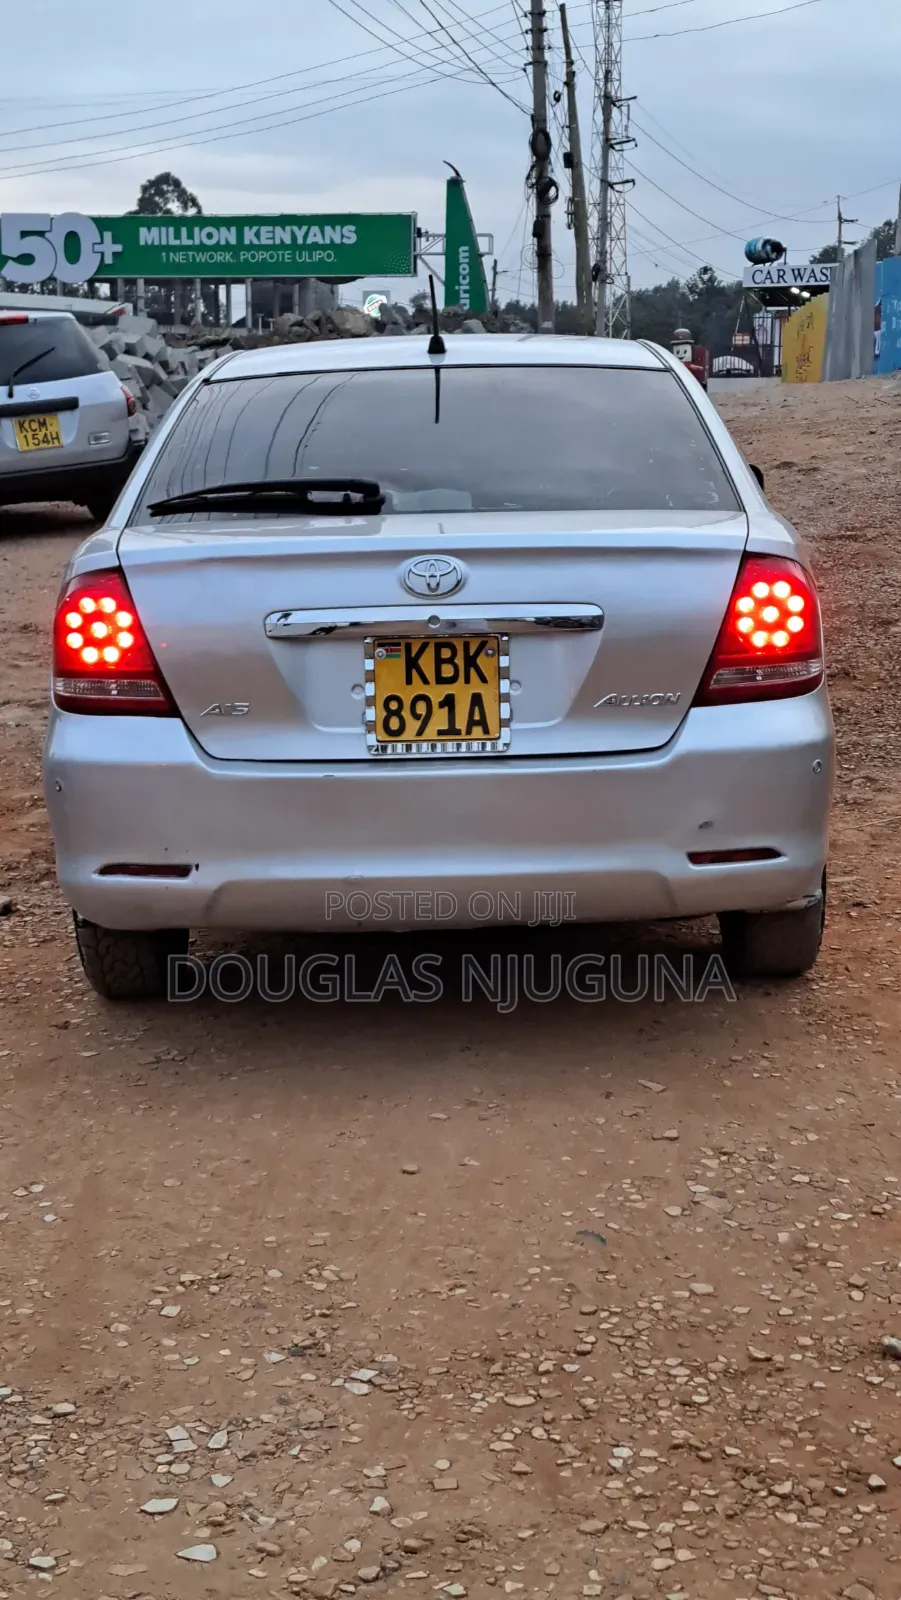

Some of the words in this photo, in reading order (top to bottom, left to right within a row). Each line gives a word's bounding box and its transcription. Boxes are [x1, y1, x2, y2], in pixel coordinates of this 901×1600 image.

[139, 226, 237, 246] MILLION
[243, 225, 357, 245] KENYANS
[0, 212, 123, 284] 50+
[161, 252, 167, 263] 1
[169, 251, 236, 263] NETWORK.
[240, 250, 292, 263] POPOTE
[296, 250, 337, 262] ULIPO.
[752, 268, 788, 285] CAR
[18, 417, 48, 433] KCM
[23, 431, 60, 447] 154H
[404, 640, 488, 686] KBK
[382, 692, 490, 737] 891A
